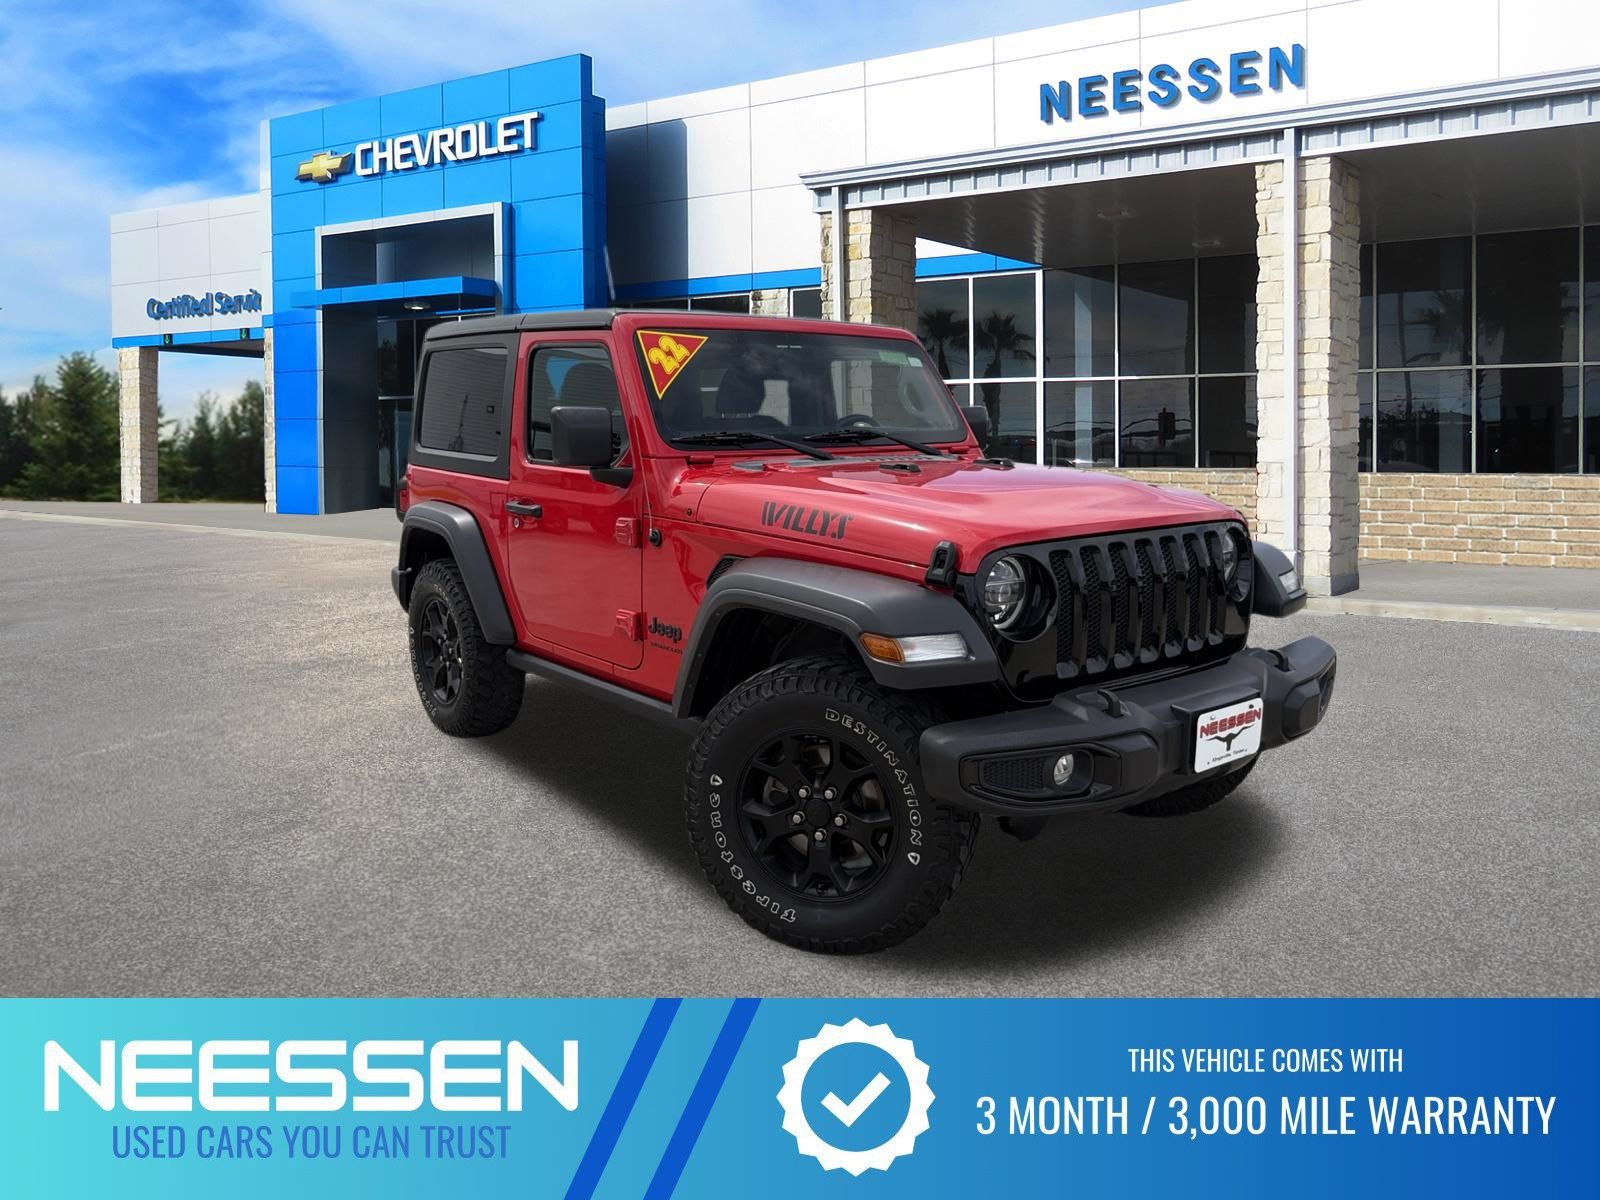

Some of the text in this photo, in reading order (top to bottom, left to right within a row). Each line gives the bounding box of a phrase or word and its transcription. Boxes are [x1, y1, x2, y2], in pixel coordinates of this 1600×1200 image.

[1040, 44, 1306, 125] NEESSEN
[354, 111, 542, 178] CHEVROLET
[146, 292, 214, 321] Certified
[648, 335, 690, 375] 22
[761, 501, 854, 540] WILLYS
[648, 616, 682, 644] Jeep
[1200, 707, 1262, 739] NEESSEN
[825, 708, 922, 846] DESTINATION
